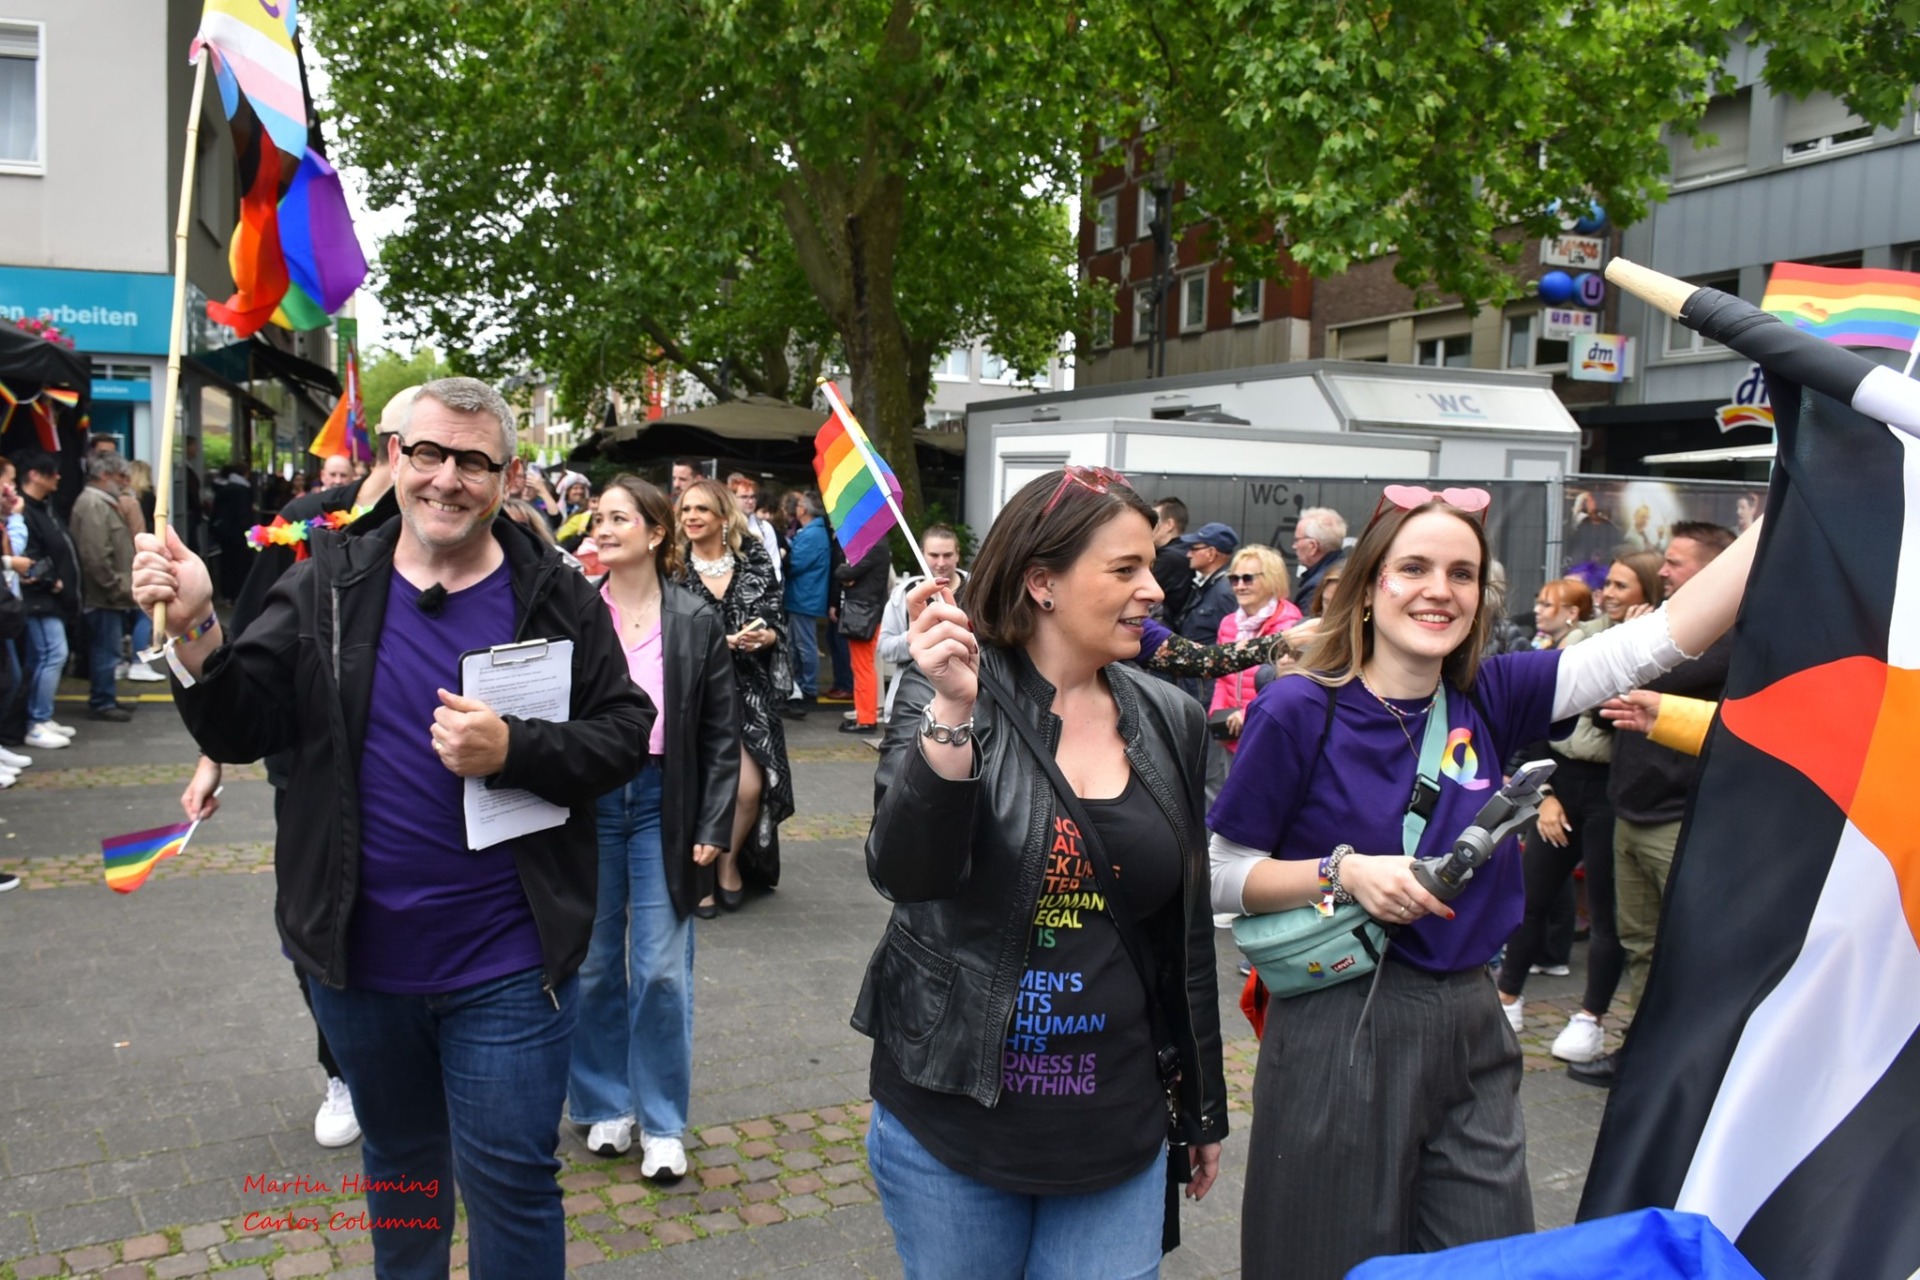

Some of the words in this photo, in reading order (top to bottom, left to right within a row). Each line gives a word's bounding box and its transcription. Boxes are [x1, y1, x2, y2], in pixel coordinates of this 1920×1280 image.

[37, 305, 138, 326] arbeiten
[1588, 342, 1612, 361] dm
[1428, 393, 1481, 413] WC
[1251, 484, 1289, 505] WC
[1053, 834, 1080, 856] AL
[1046, 854, 1072, 875] CK
[1045, 876, 1080, 894] TER
[1037, 892, 1104, 911] HUMAN
[1034, 909, 1082, 928] EGAL
[1037, 928, 1056, 948] IS
[1019, 970, 1083, 992] MEN'S
[1015, 1012, 1106, 1035] HUMAN
[1005, 1033, 1048, 1053] HTS
[1003, 1052, 1073, 1074] DNESS
[1078, 1053, 1096, 1073] IS
[1003, 1072, 1096, 1095] RYTHING
